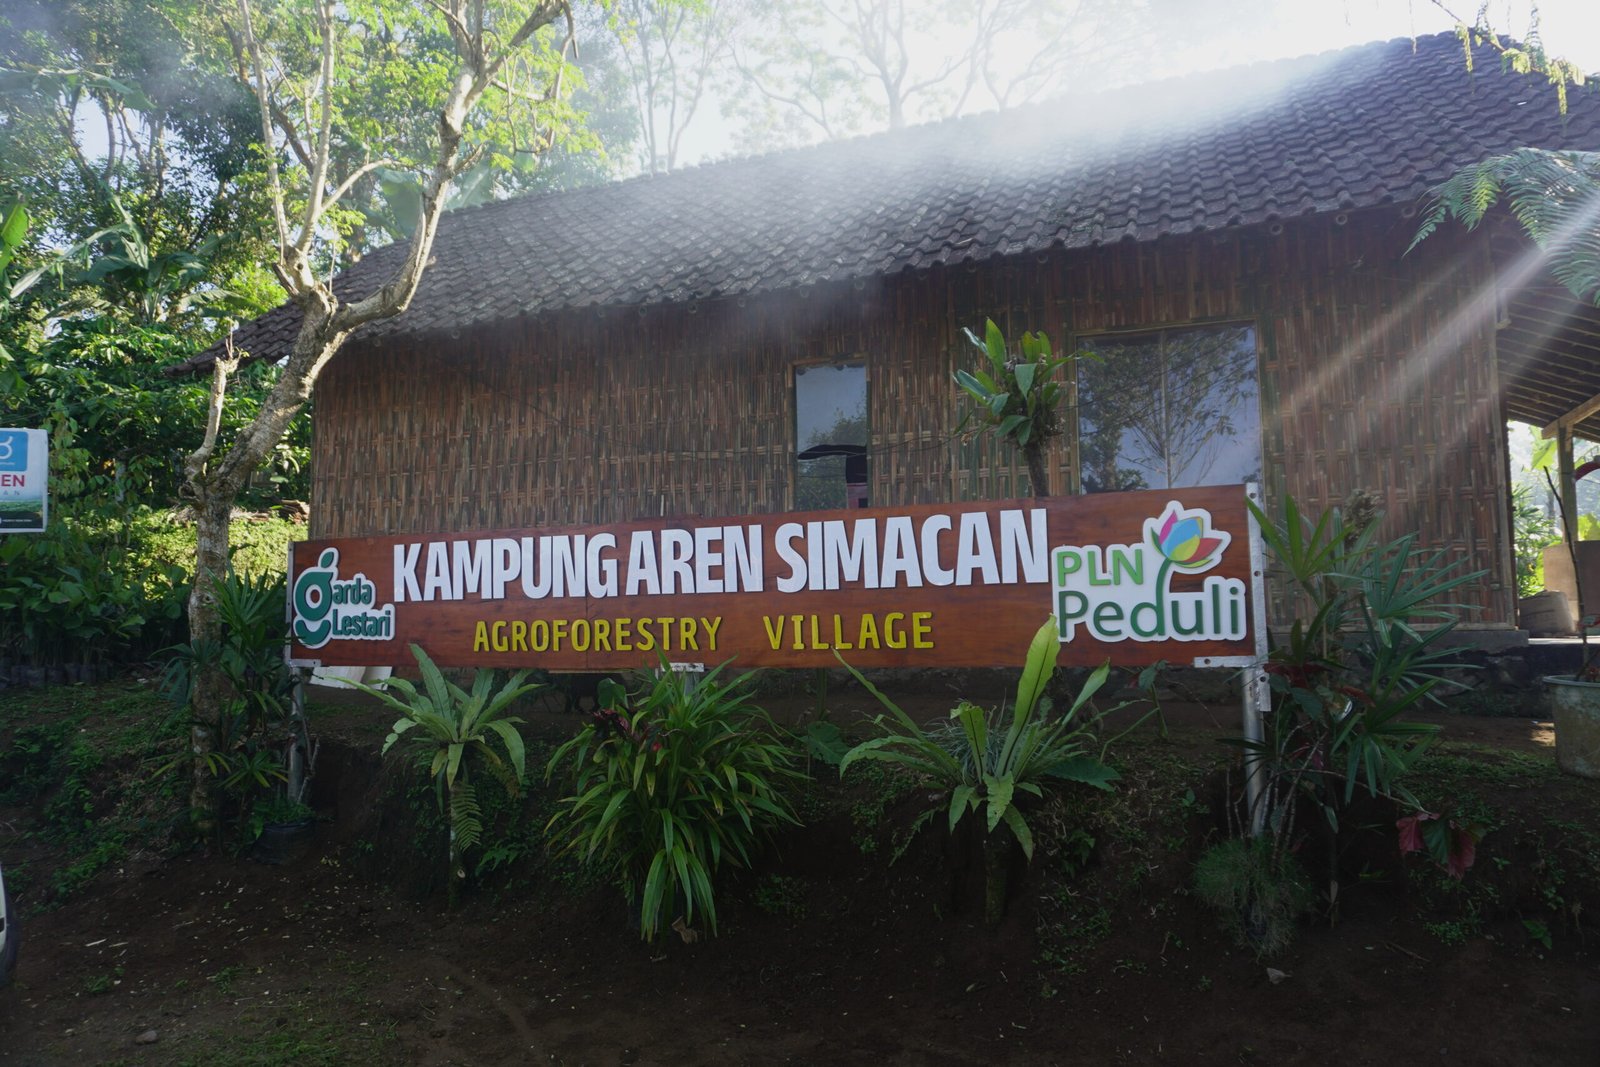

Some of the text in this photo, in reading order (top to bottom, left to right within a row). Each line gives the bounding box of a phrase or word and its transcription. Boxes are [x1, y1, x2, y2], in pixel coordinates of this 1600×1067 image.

[393, 508, 1049, 601] KAMPUNG AREN SIMACAN
[1057, 548, 1144, 587] PLN
[333, 608, 391, 637] Lestari
[473, 611, 934, 652] AGROFORESTRY VILLAGE
[1059, 584, 1241, 638] Peduli
